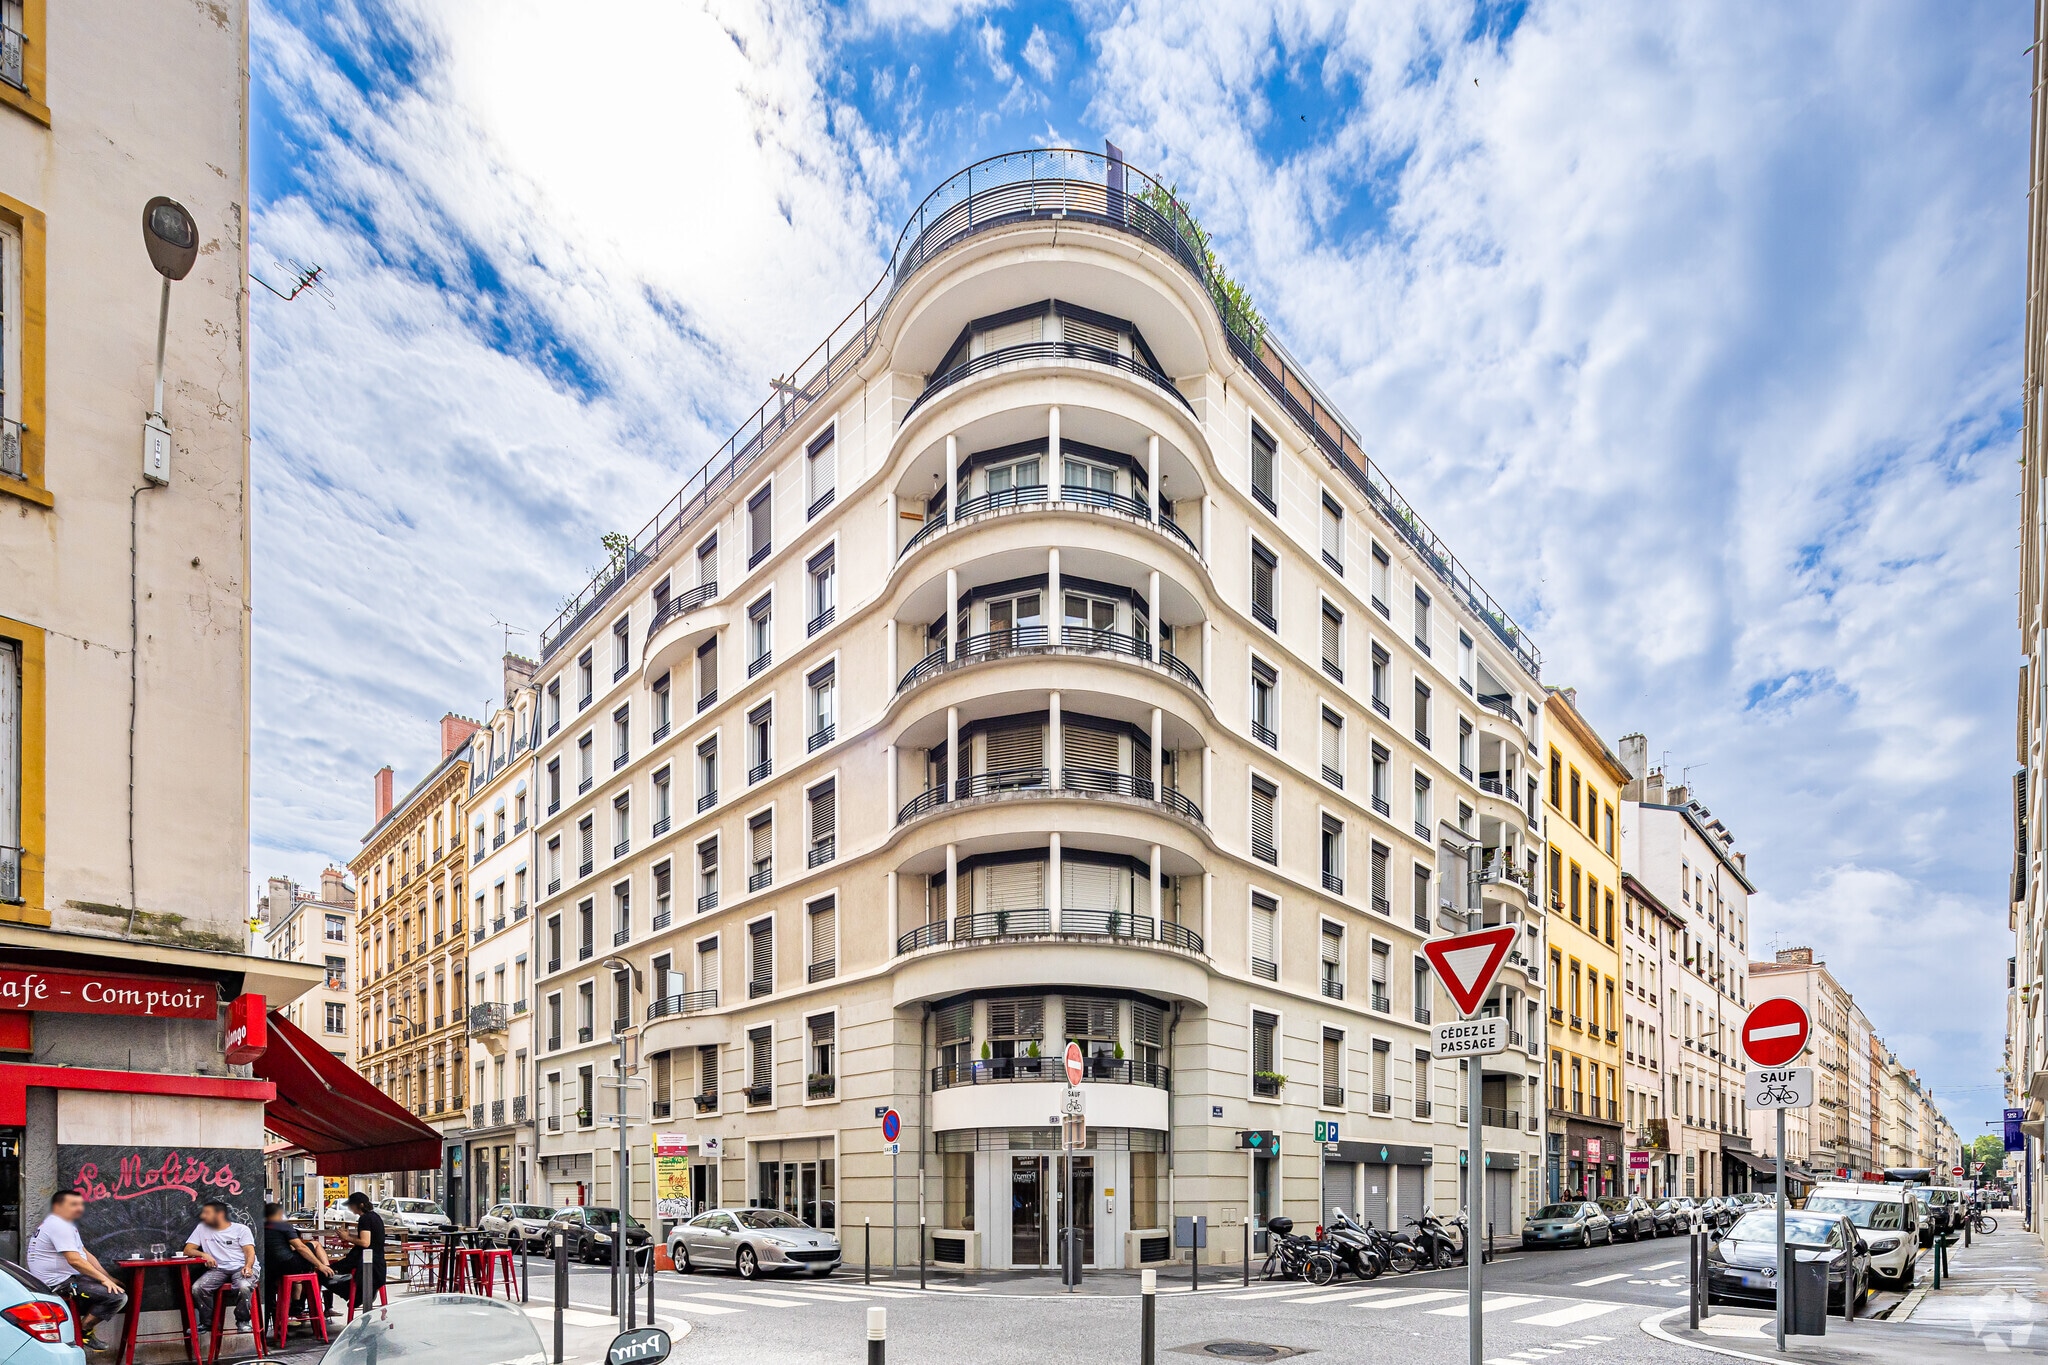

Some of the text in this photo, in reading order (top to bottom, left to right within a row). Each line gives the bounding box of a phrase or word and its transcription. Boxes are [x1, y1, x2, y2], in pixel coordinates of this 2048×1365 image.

[0, 974, 49, 1008] afé
[82, 982, 205, 1015] Comptoir
[1441, 1024, 1496, 1039] CÉDEZ LE
[1441, 1038, 1496, 1053] PASSAGE
[1760, 1071, 1796, 1083] SAUF
[1318, 1124, 1323, 1138] P
[1330, 1125, 1336, 1139] P
